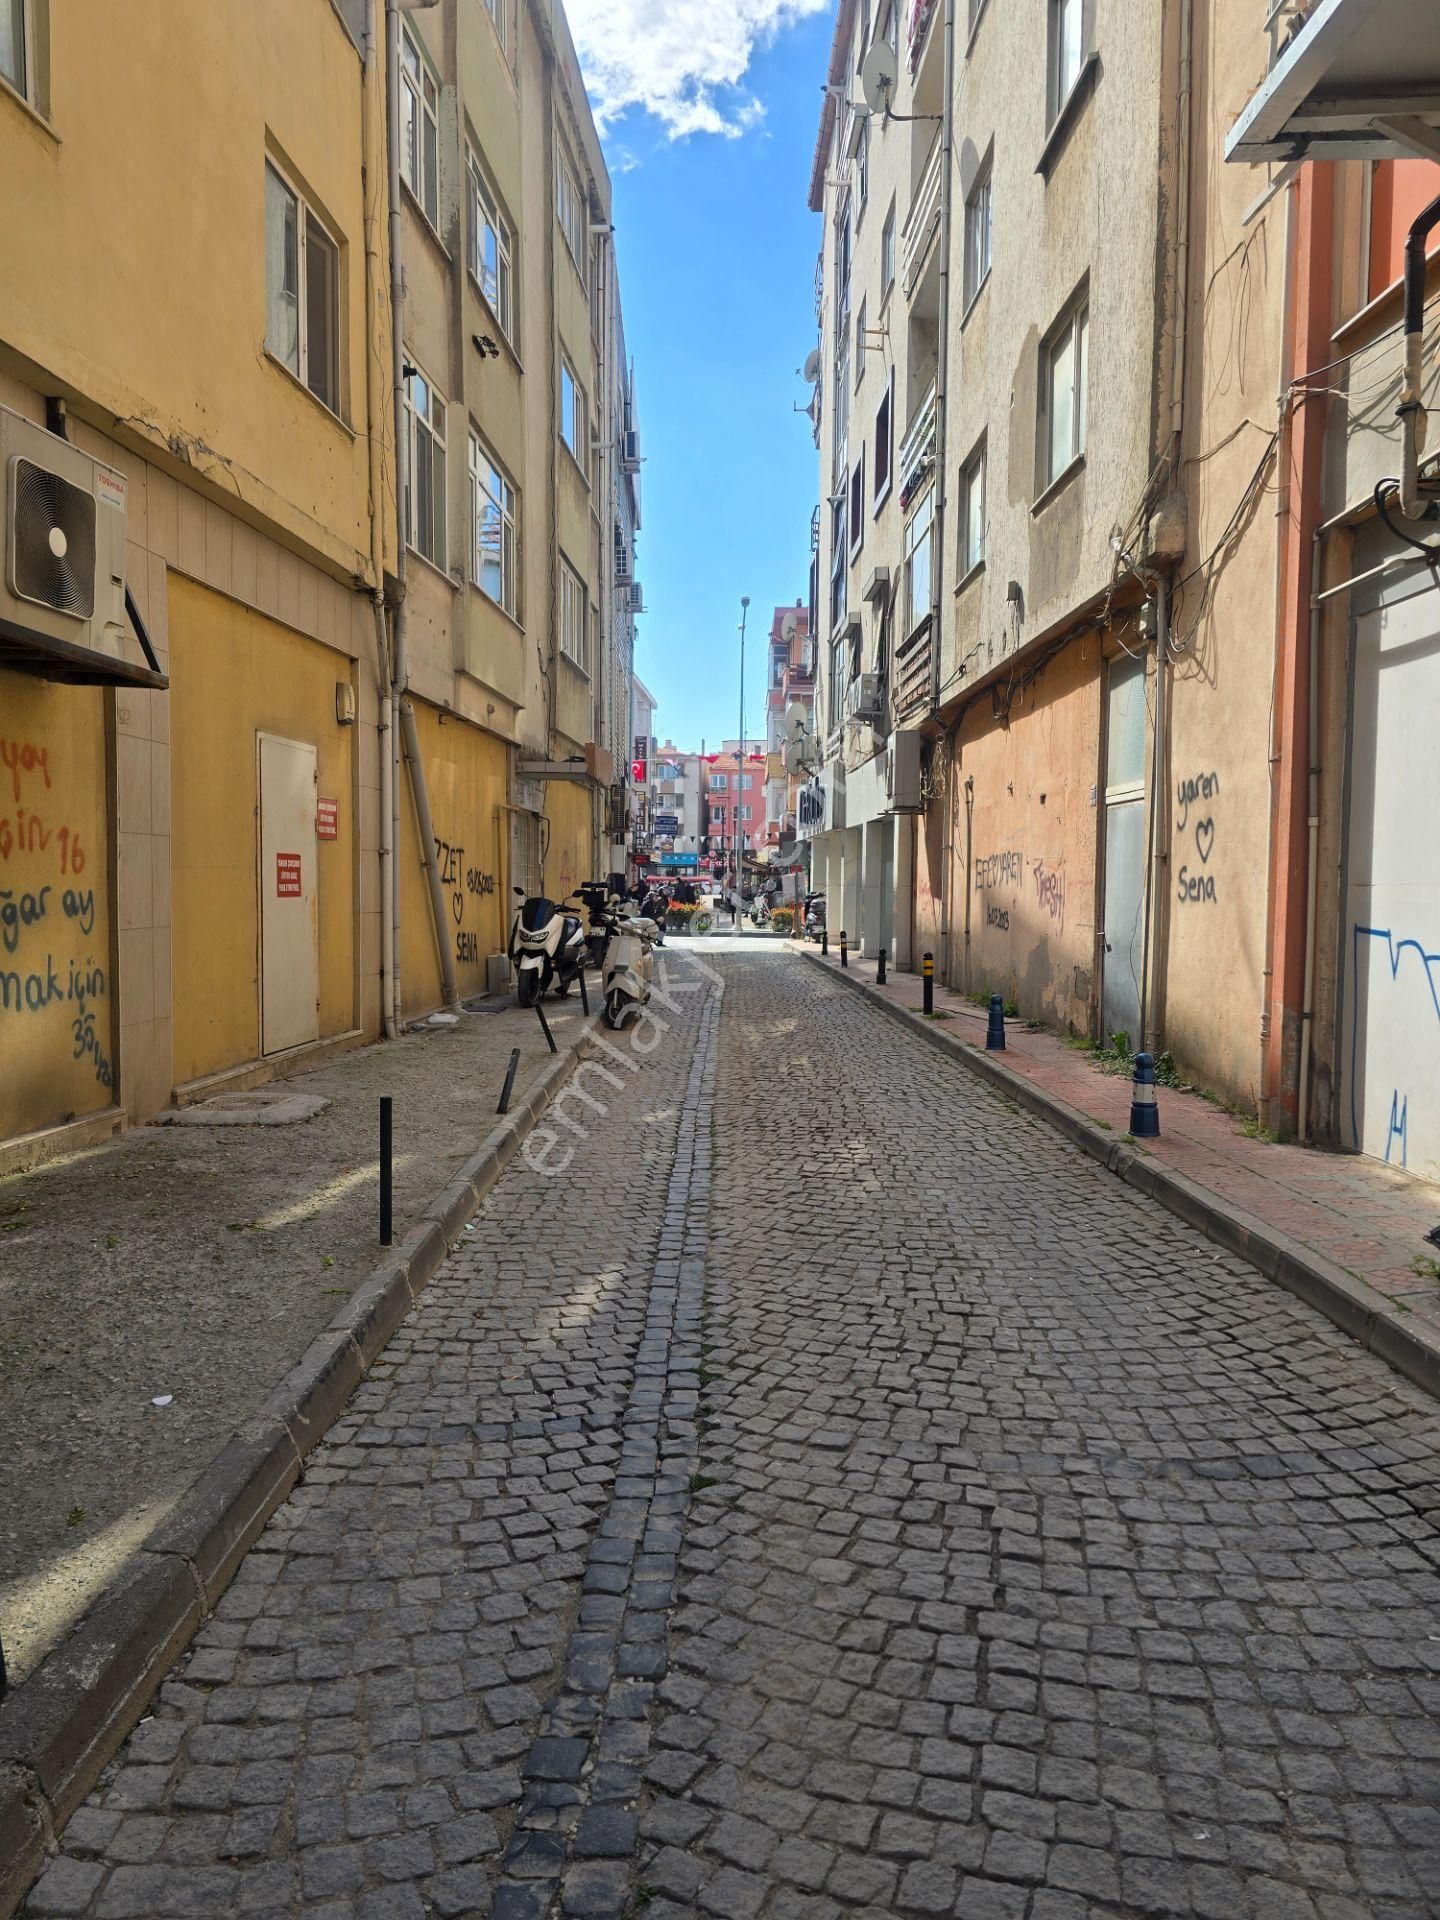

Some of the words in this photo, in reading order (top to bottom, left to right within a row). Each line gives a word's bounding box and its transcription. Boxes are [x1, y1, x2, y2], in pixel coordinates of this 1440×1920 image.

[98, 474, 124, 493] TOSHIBA
[1177, 771, 1219, 832] yaren
[1177, 865, 1217, 904] Sena
[456, 931, 478, 964] SENA
